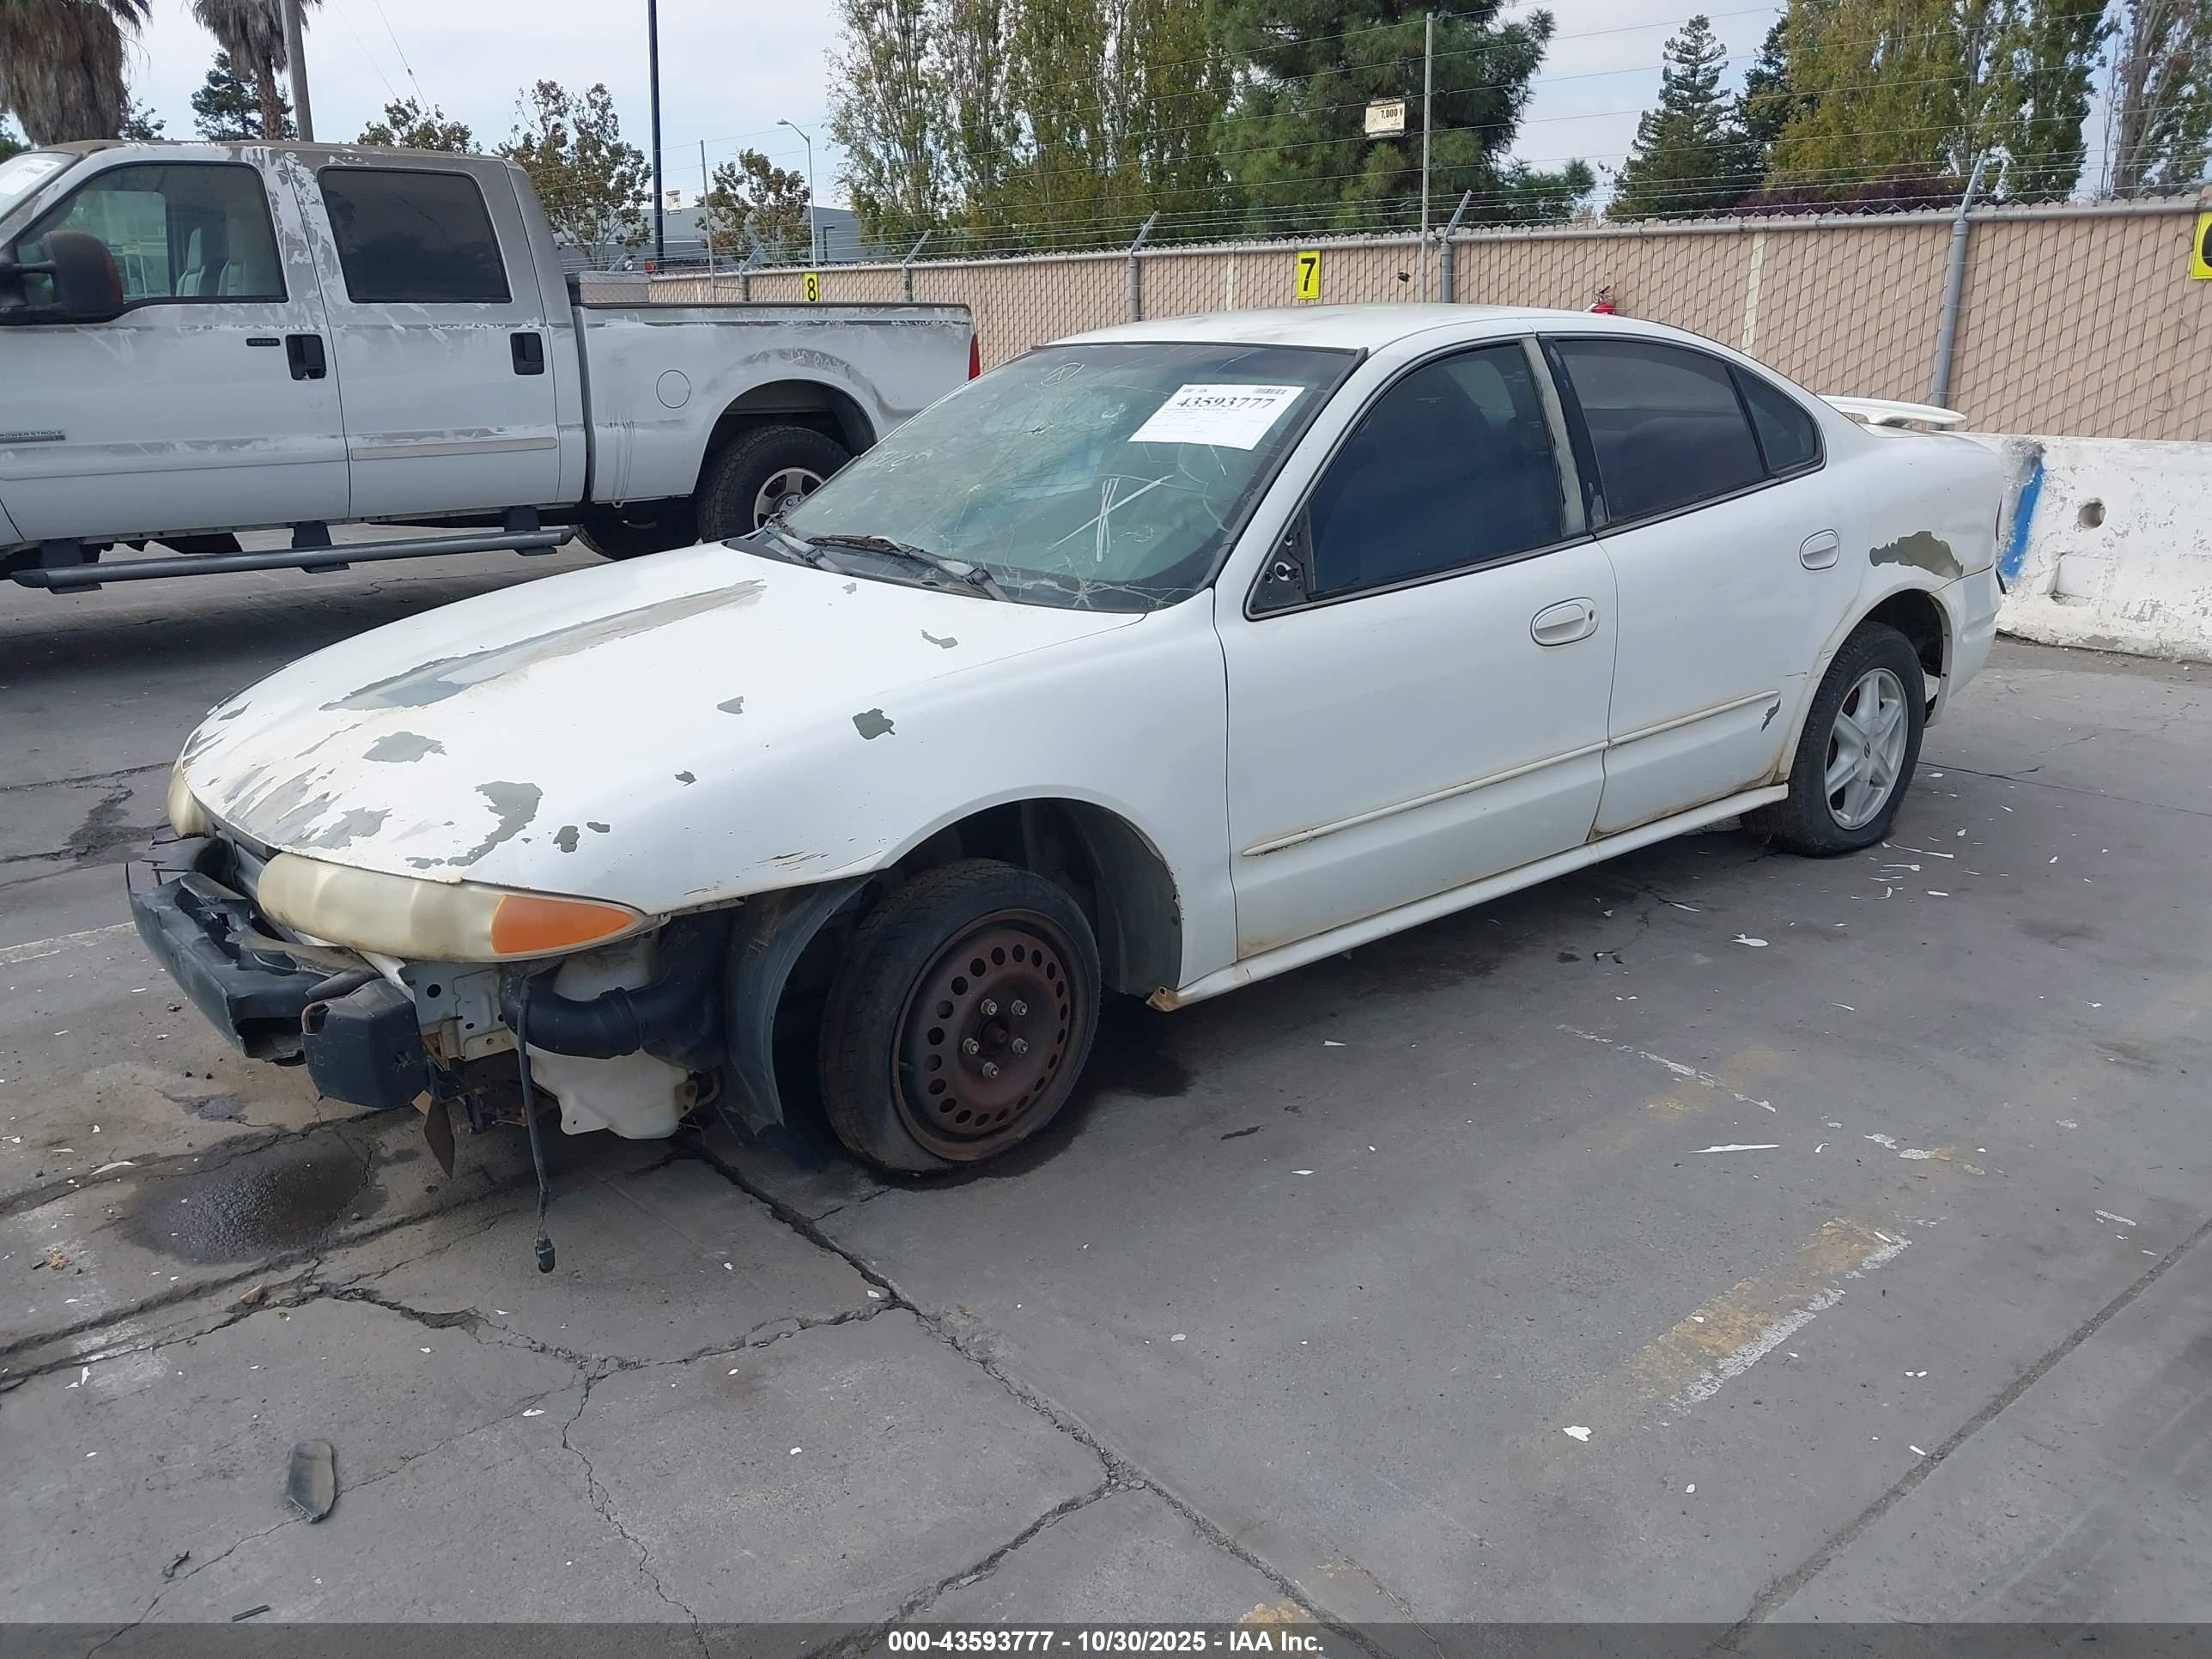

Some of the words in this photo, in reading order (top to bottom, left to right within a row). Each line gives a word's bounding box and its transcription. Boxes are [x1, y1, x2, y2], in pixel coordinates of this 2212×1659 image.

[1380, 107, 1398, 119] 7,000
[1399, 107, 1404, 117] V
[1300, 257, 1316, 292] 7
[807, 277, 817, 301] 8
[1176, 397, 1277, 410] 43593777
